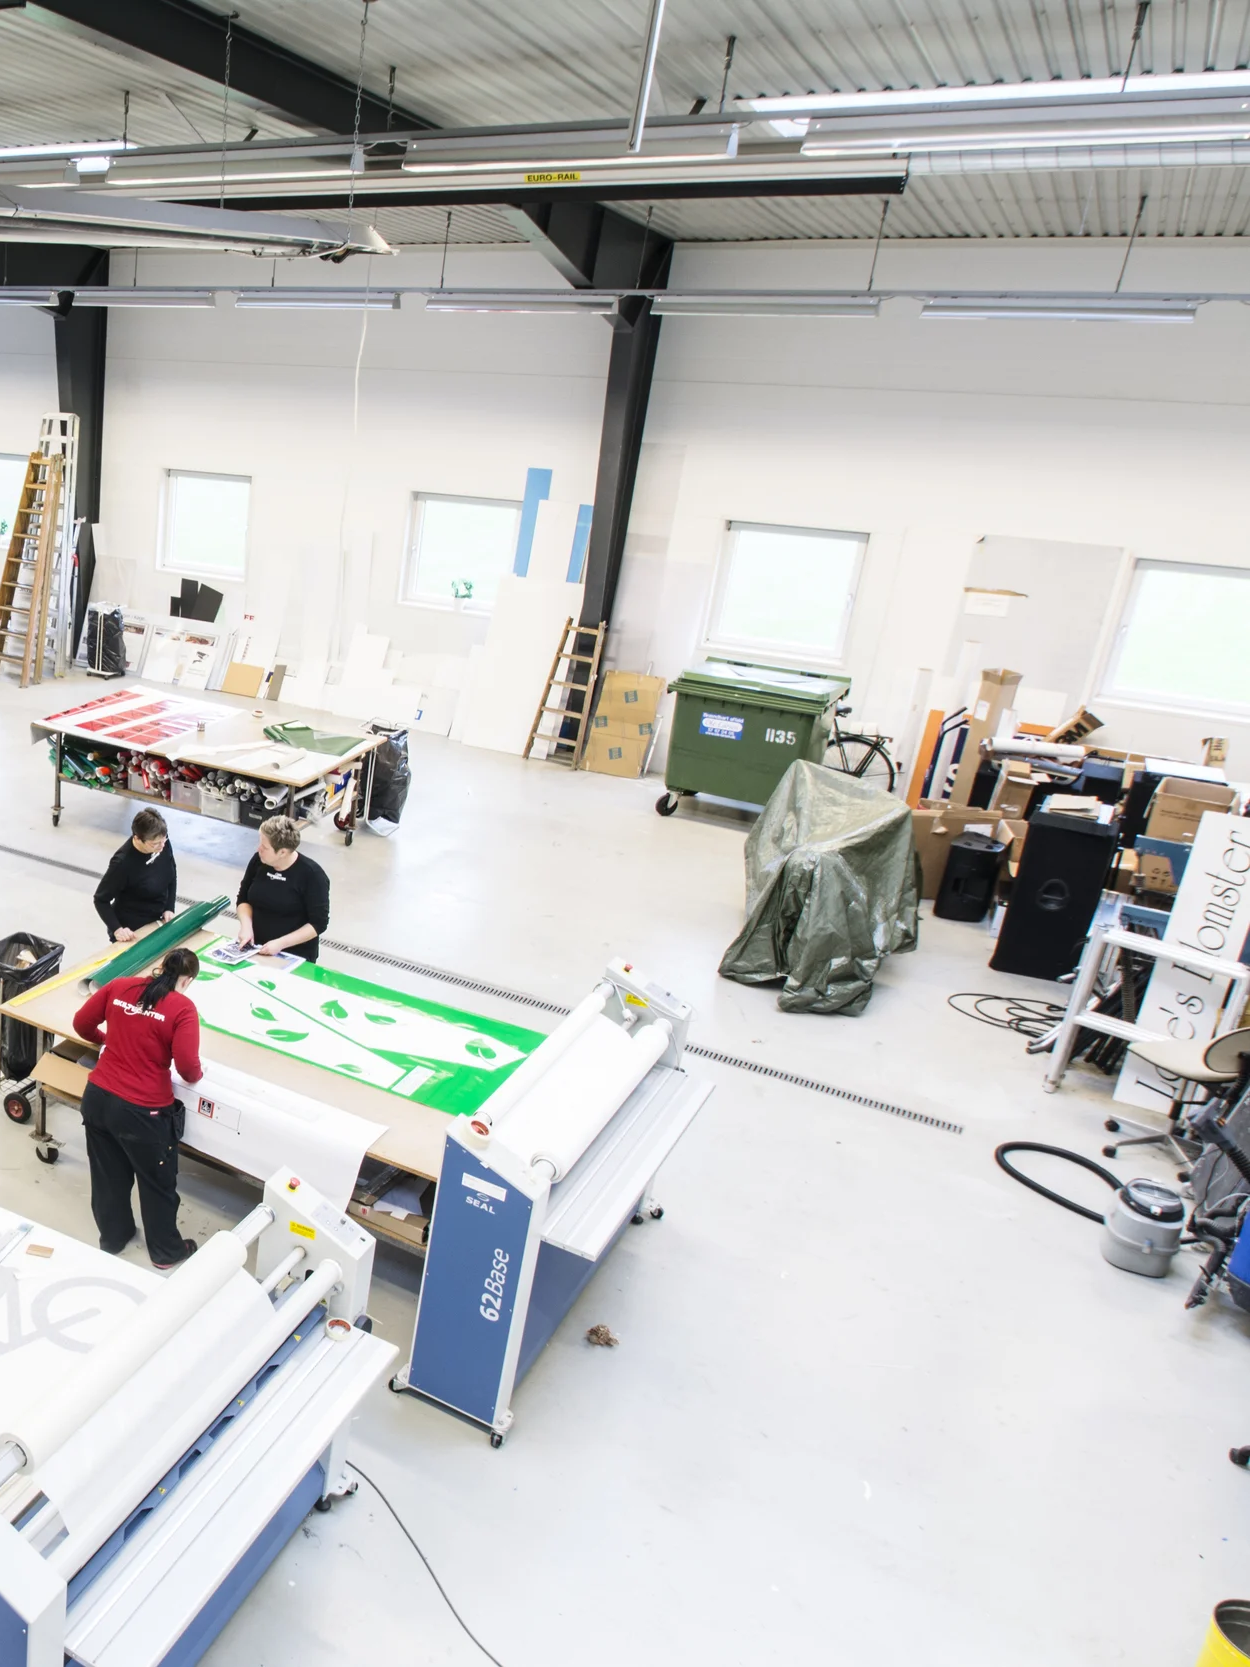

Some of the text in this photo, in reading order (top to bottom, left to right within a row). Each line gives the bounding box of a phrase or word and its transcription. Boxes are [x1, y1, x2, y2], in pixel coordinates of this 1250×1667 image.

[527, 172, 578, 182] EURO-RAIL
[765, 728, 797, 746] 1135
[1054, 722, 1090, 744] 3M
[465, 1195, 496, 1215] SEAL
[479, 1248, 510, 1322] 62Base
